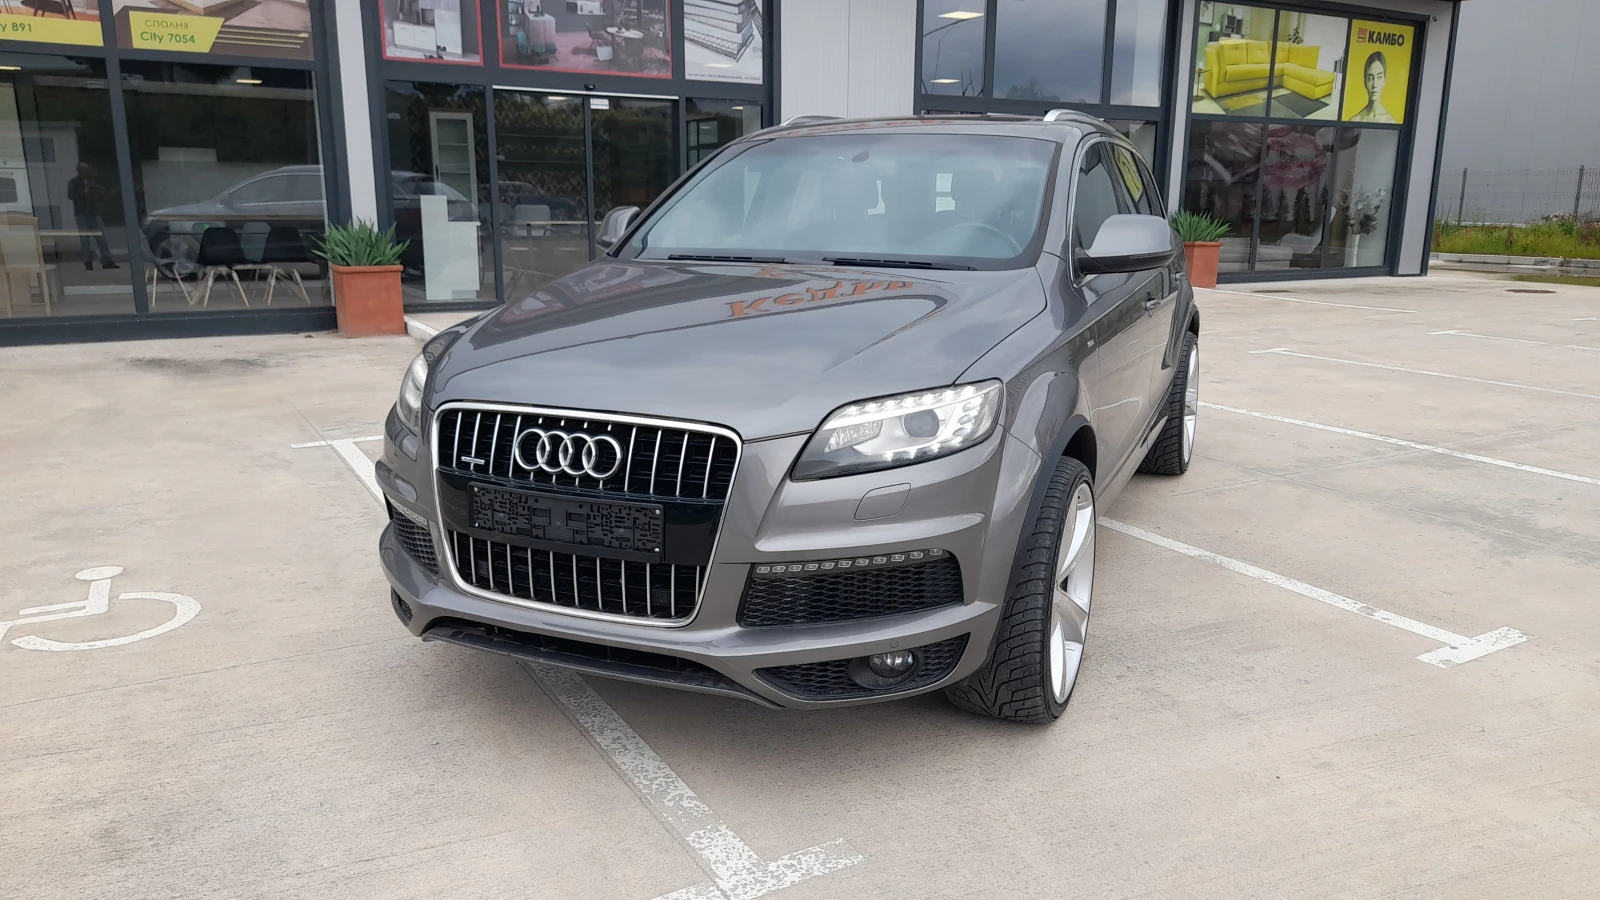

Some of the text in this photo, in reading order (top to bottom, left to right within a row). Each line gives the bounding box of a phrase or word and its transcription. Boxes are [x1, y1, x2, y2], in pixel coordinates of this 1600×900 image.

[12, 22, 32, 32] 891
[140, 31, 195, 44] City 7054
[1368, 30, 1405, 46] КАМБО
